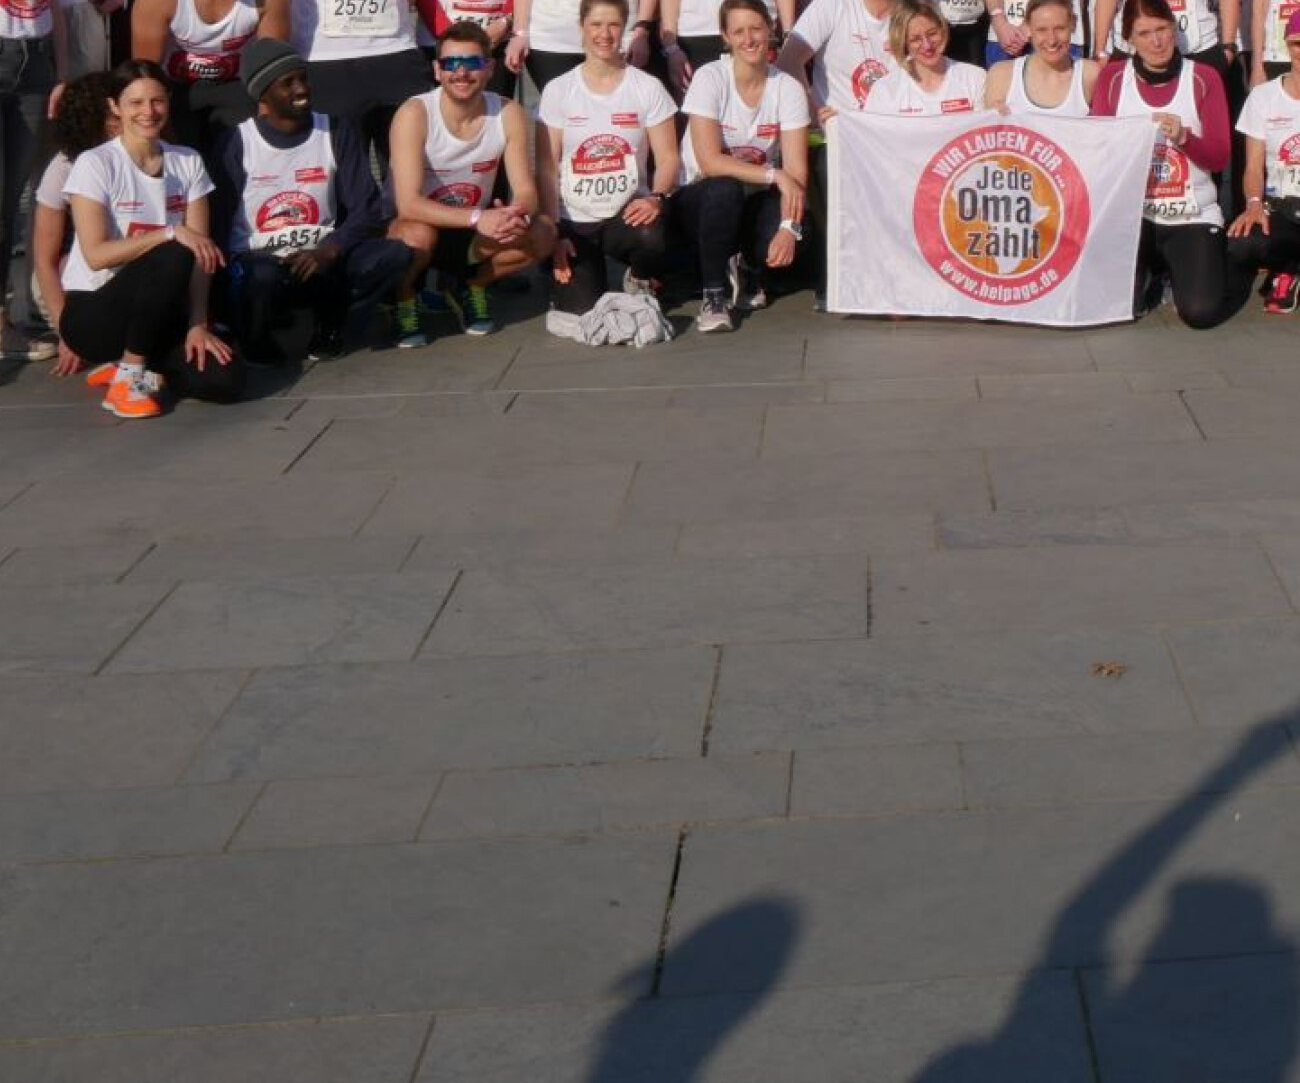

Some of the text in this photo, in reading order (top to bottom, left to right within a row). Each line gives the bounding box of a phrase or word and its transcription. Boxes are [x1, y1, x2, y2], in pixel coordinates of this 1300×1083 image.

[932, 147, 967, 178] WIR
[964, 131, 1029, 155] LAUFEN
[1030, 141, 1063, 171] FÜR
[573, 175, 628, 196] 47003
[976, 166, 1033, 191] Jede
[958, 187, 1033, 225] Oma
[967, 225, 1040, 259] zählt
[941, 260, 1059, 302] www.helpage.de
